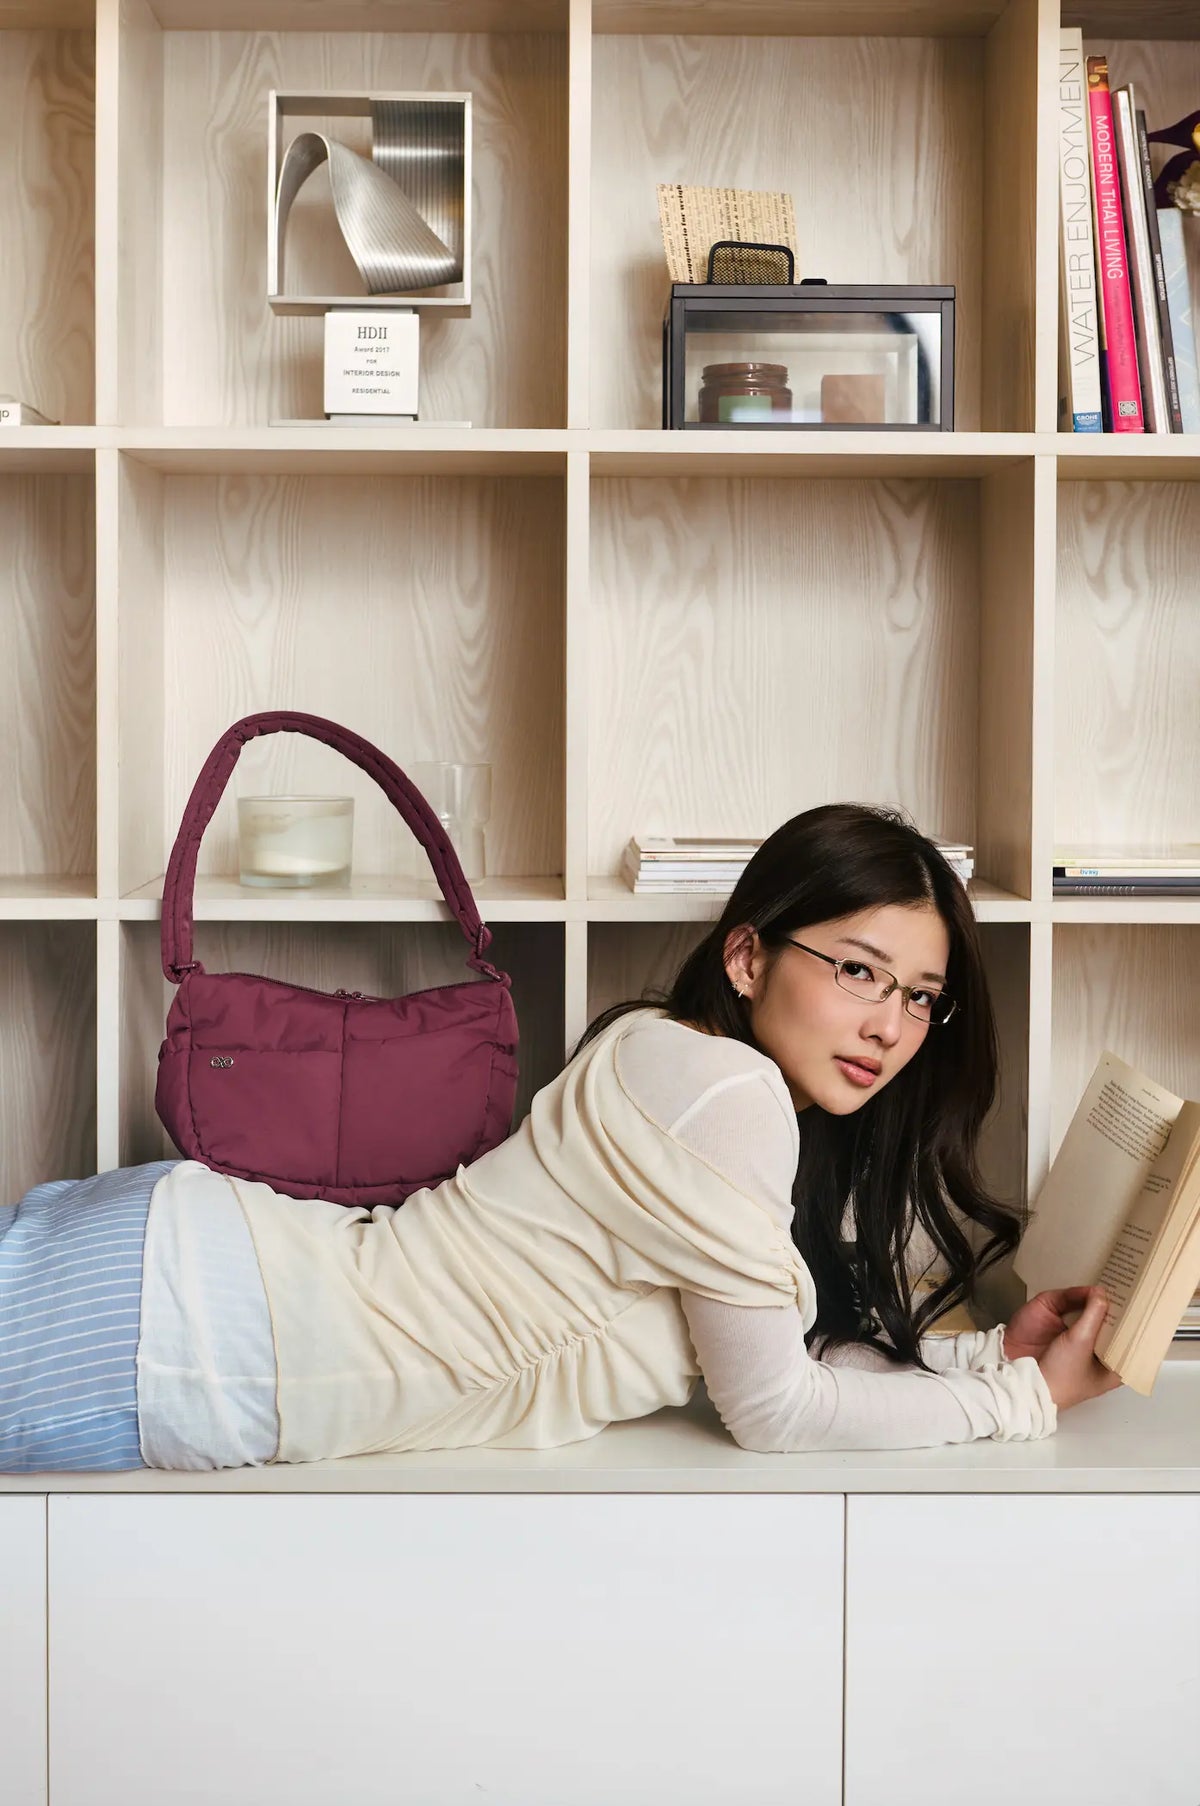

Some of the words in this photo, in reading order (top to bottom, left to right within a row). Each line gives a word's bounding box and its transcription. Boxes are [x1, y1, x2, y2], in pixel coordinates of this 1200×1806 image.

[1096, 115, 1114, 185] MODERN
[1101, 189, 1118, 224] THAI
[1104, 230, 1124, 280] LIVING
[357, 326, 388, 340] HDII
[1068, 252, 1095, 366] WATER
